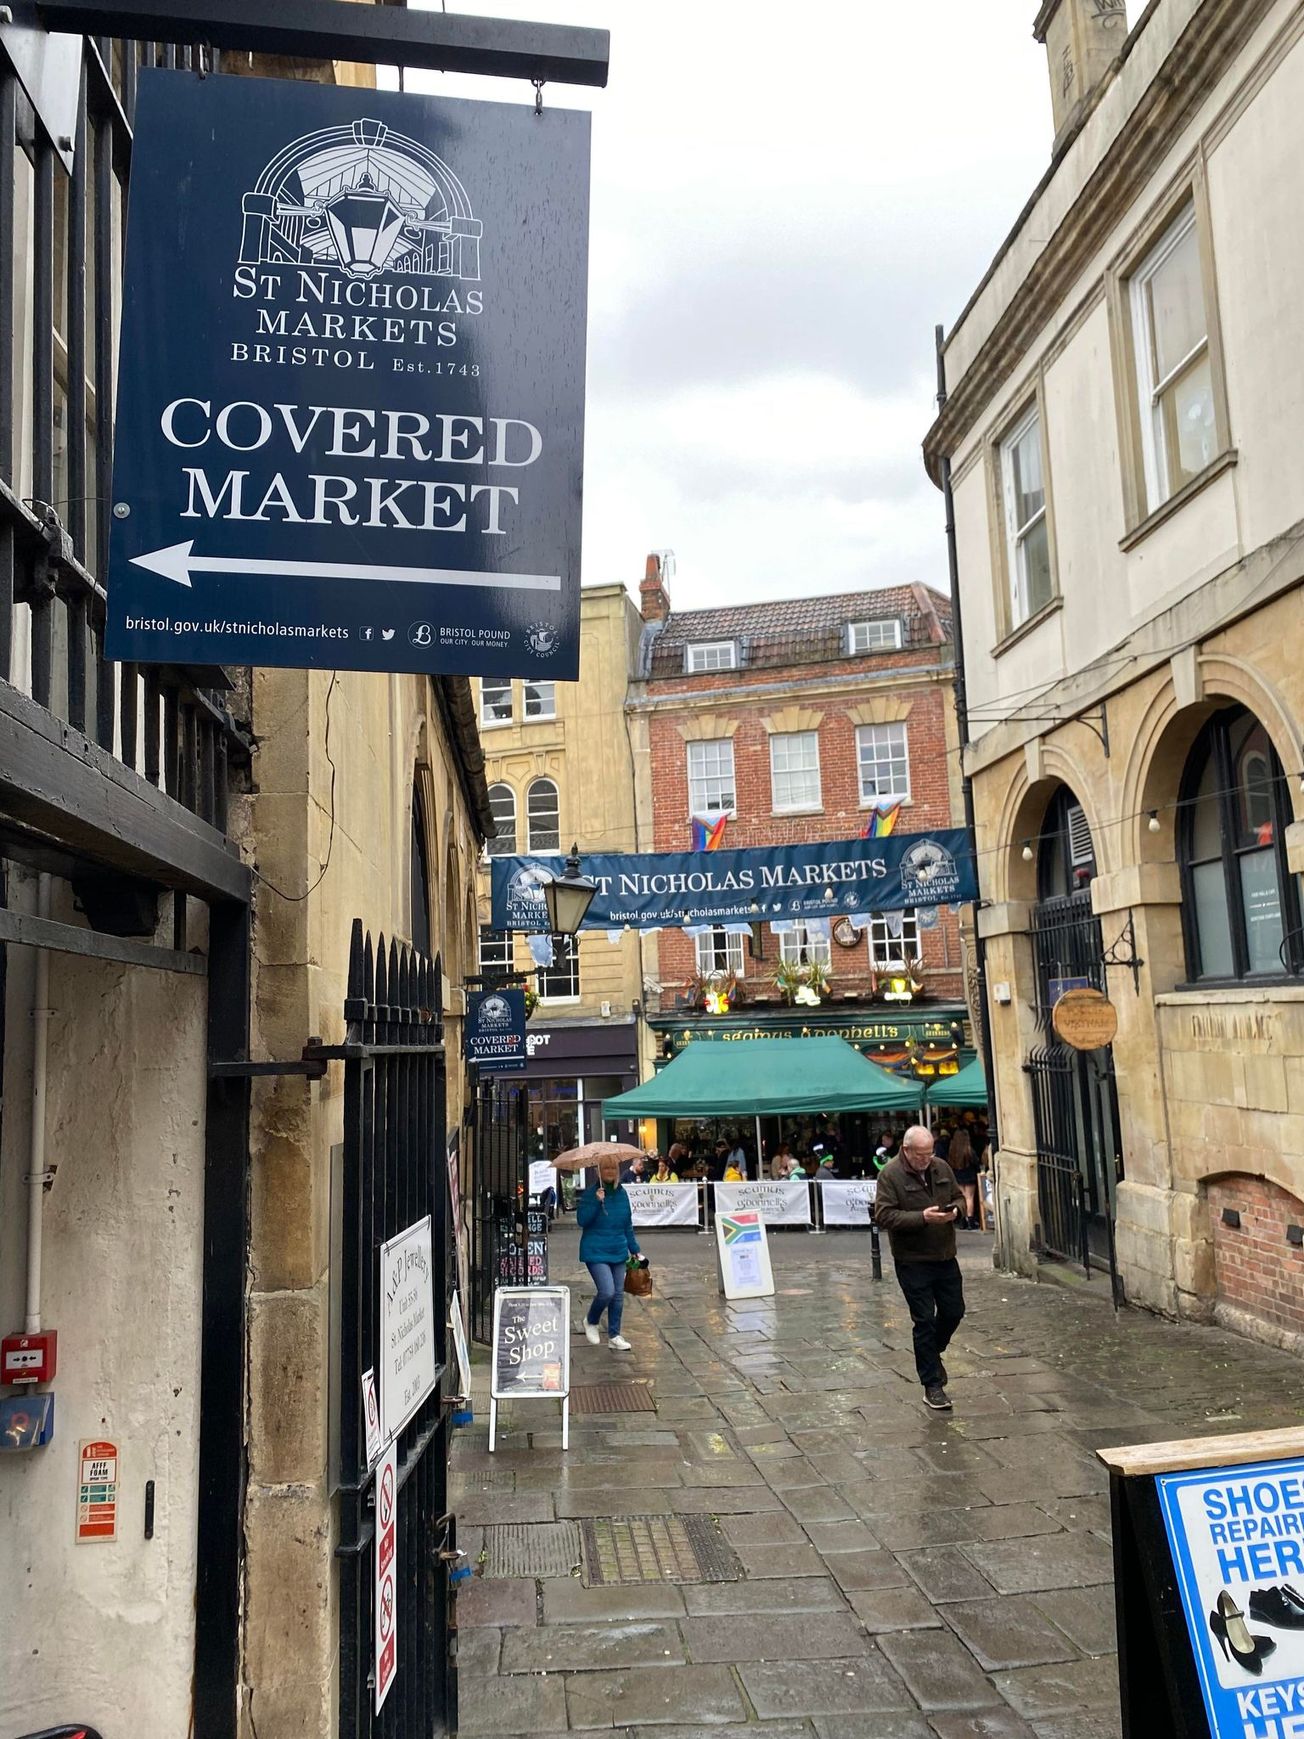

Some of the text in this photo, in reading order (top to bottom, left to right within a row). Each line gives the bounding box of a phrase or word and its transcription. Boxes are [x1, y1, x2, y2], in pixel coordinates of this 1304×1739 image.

[296, 270, 484, 315] NICHOLAS
[255, 308, 458, 347] MARKETS
[230, 342, 376, 370] BRISTOL
[160, 397, 543, 467] COVERED
[179, 467, 520, 535] MARKET
[125, 615, 349, 639] bristol.gov.uk/stnicholasmarkets
[440, 627, 511, 640] BRISTOL POUND
[471, 639, 485, 647] OUR
[619, 870, 754, 895] NICHOLAS
[760, 858, 887, 888] MARKETS
[908, 885, 956, 897] MARKETS
[470, 1034, 521, 1046] COVERED
[474, 1044, 519, 1055] MARKET
[504, 1316, 559, 1344] Sweet
[512, 1315, 525, 1324] The
[509, 1340, 555, 1365] Shop
[90, 1468, 109, 1477] FOAM
[1203, 1479, 1304, 1520] SHOE
[1216, 1538, 1304, 1584] HER
